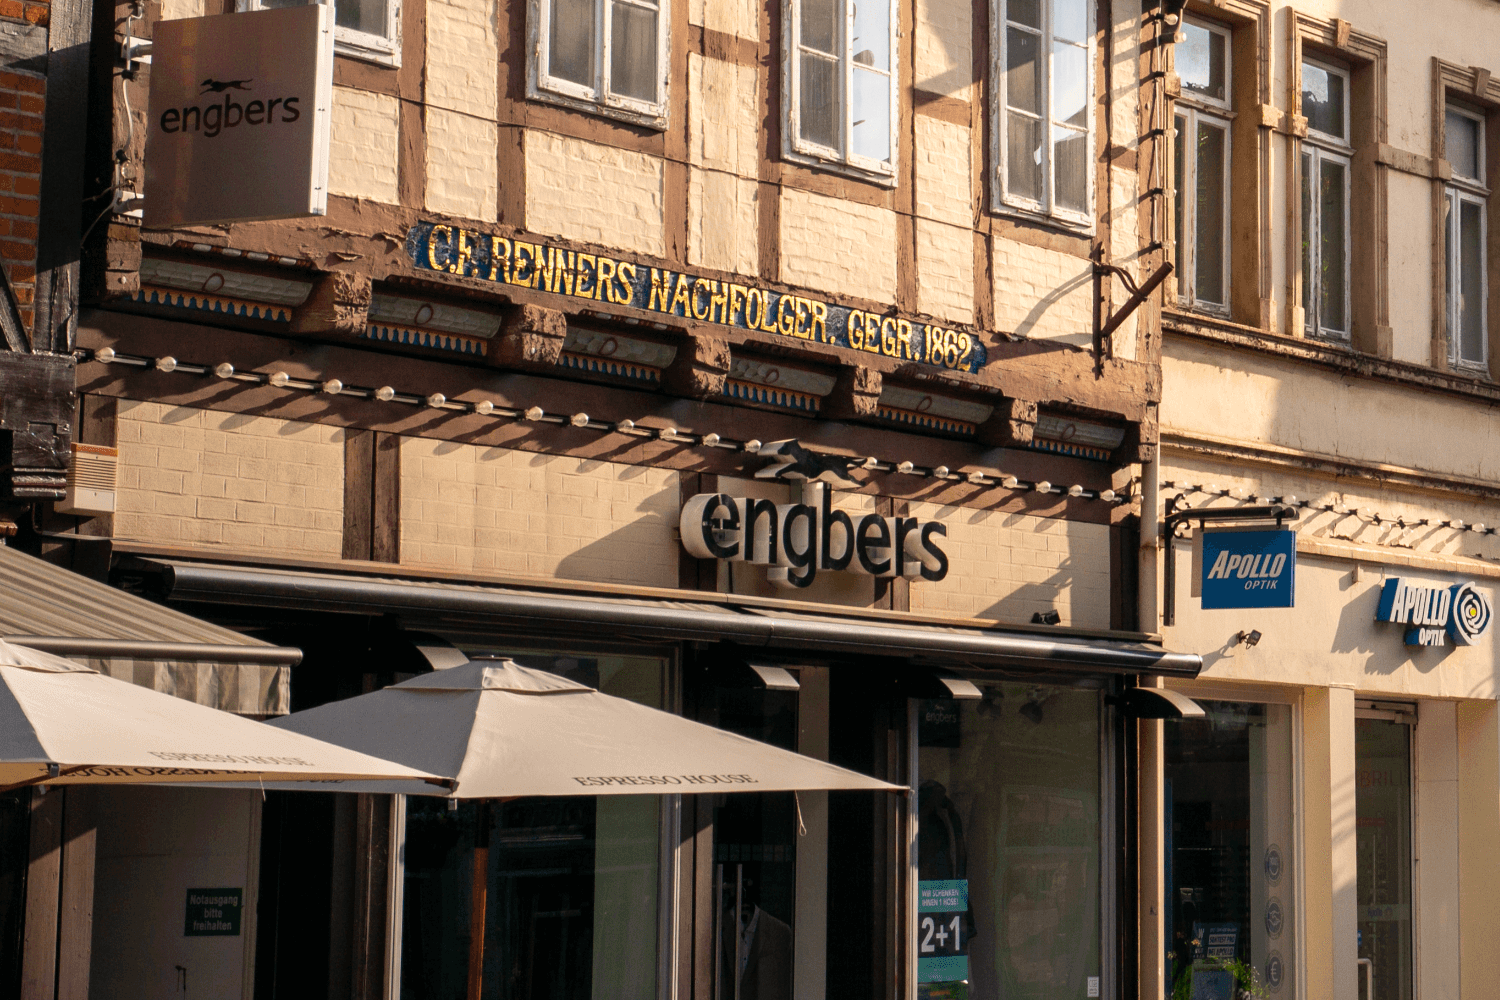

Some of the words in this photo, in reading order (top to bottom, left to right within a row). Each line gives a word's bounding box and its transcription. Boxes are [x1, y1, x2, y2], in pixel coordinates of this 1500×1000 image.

[160, 94, 300, 138] engbers
[488, 235, 637, 306] RENNERS
[648, 267, 836, 345] NACHFOLGER.
[847, 309, 921, 361] GEGR.
[922, 324, 974, 372] 1862
[697, 482, 949, 589] engbers
[1207, 550, 1287, 580] APOLLO
[1244, 580, 1279, 590] OPTIK
[1388, 577, 1452, 627] APOLLO
[1418, 627, 1446, 647] OPTIK
[572, 775, 683, 786] ESPRESSO
[680, 773, 759, 784] HOUSE
[190, 894, 239, 907] Notausgang
[193, 920, 232, 931] freihalten
[204, 908, 223, 919] bitte
[920, 915, 961, 953] 2+1
